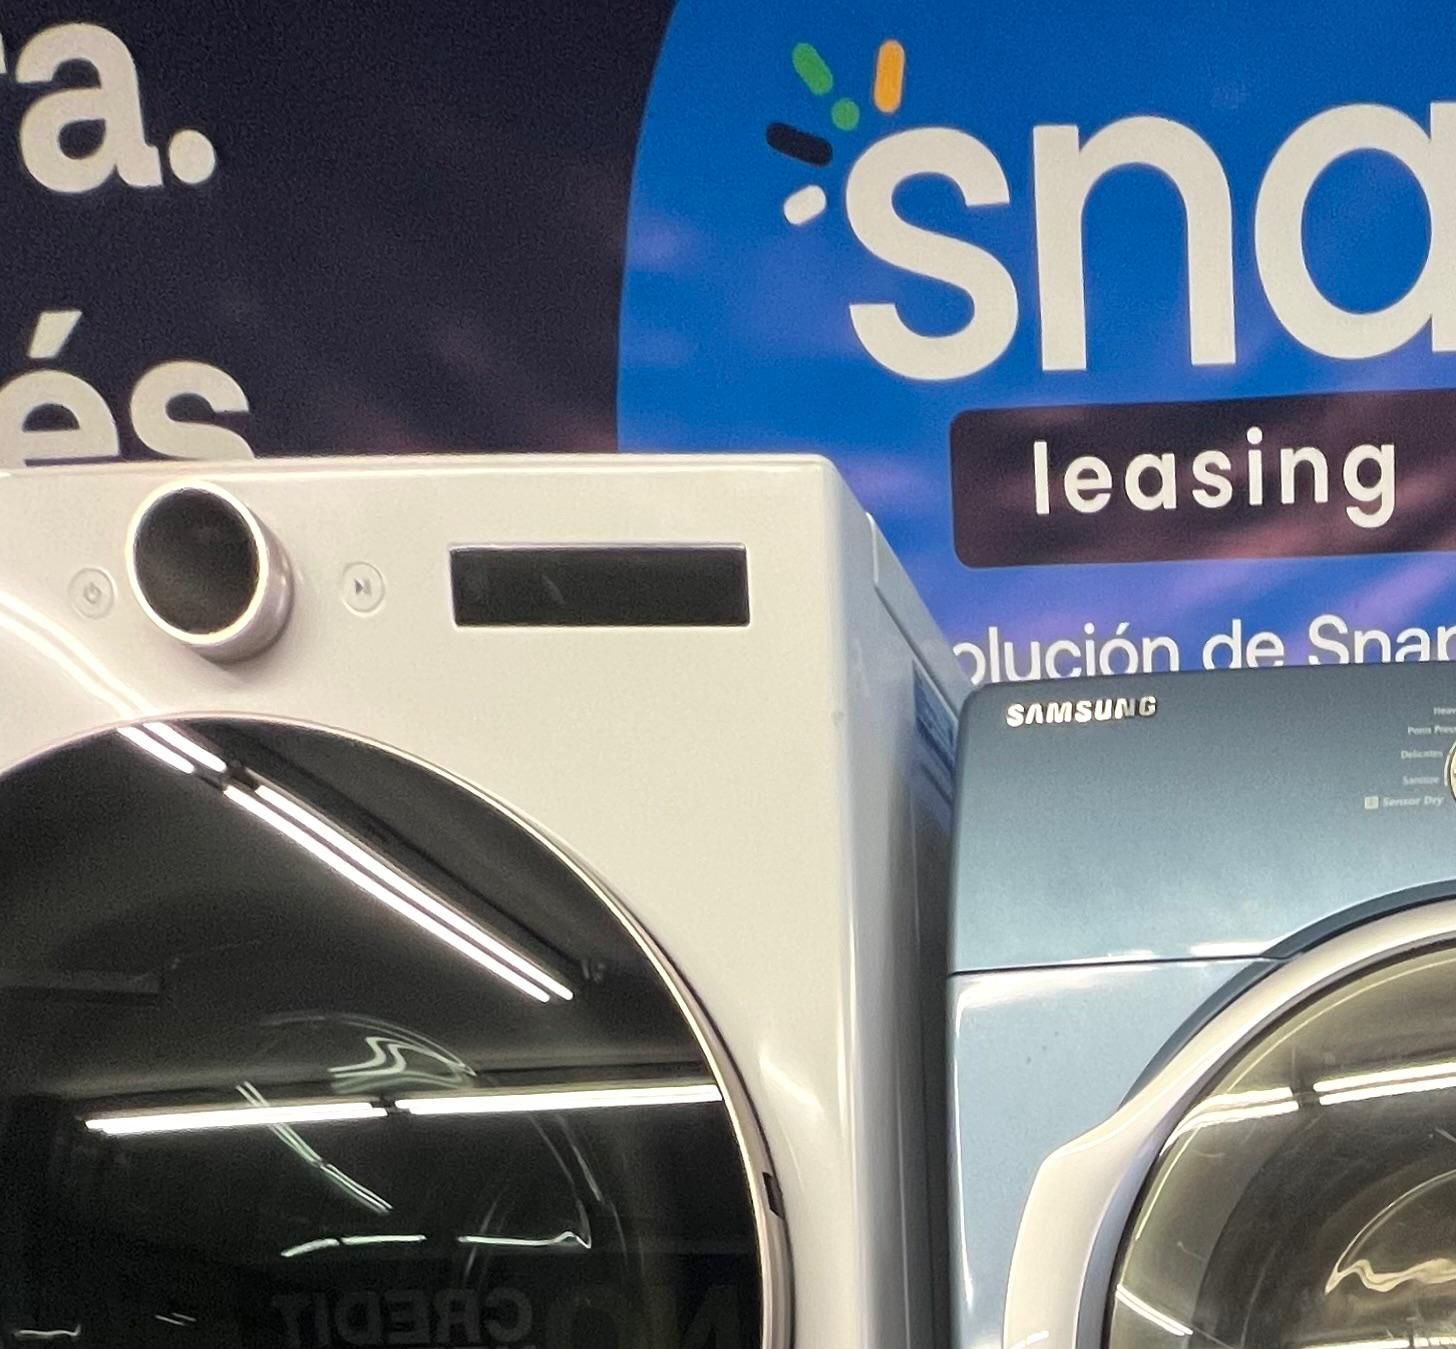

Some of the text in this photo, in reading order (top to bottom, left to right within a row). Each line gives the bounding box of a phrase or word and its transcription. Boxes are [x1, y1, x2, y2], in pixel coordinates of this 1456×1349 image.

[0, 22, 216, 194] a.
[1034, 426, 1396, 528] leasing
[1203, 618, 1285, 670] de
[1006, 696, 1158, 728] SAMSUNG
[1424, 795, 1445, 807] Dry
